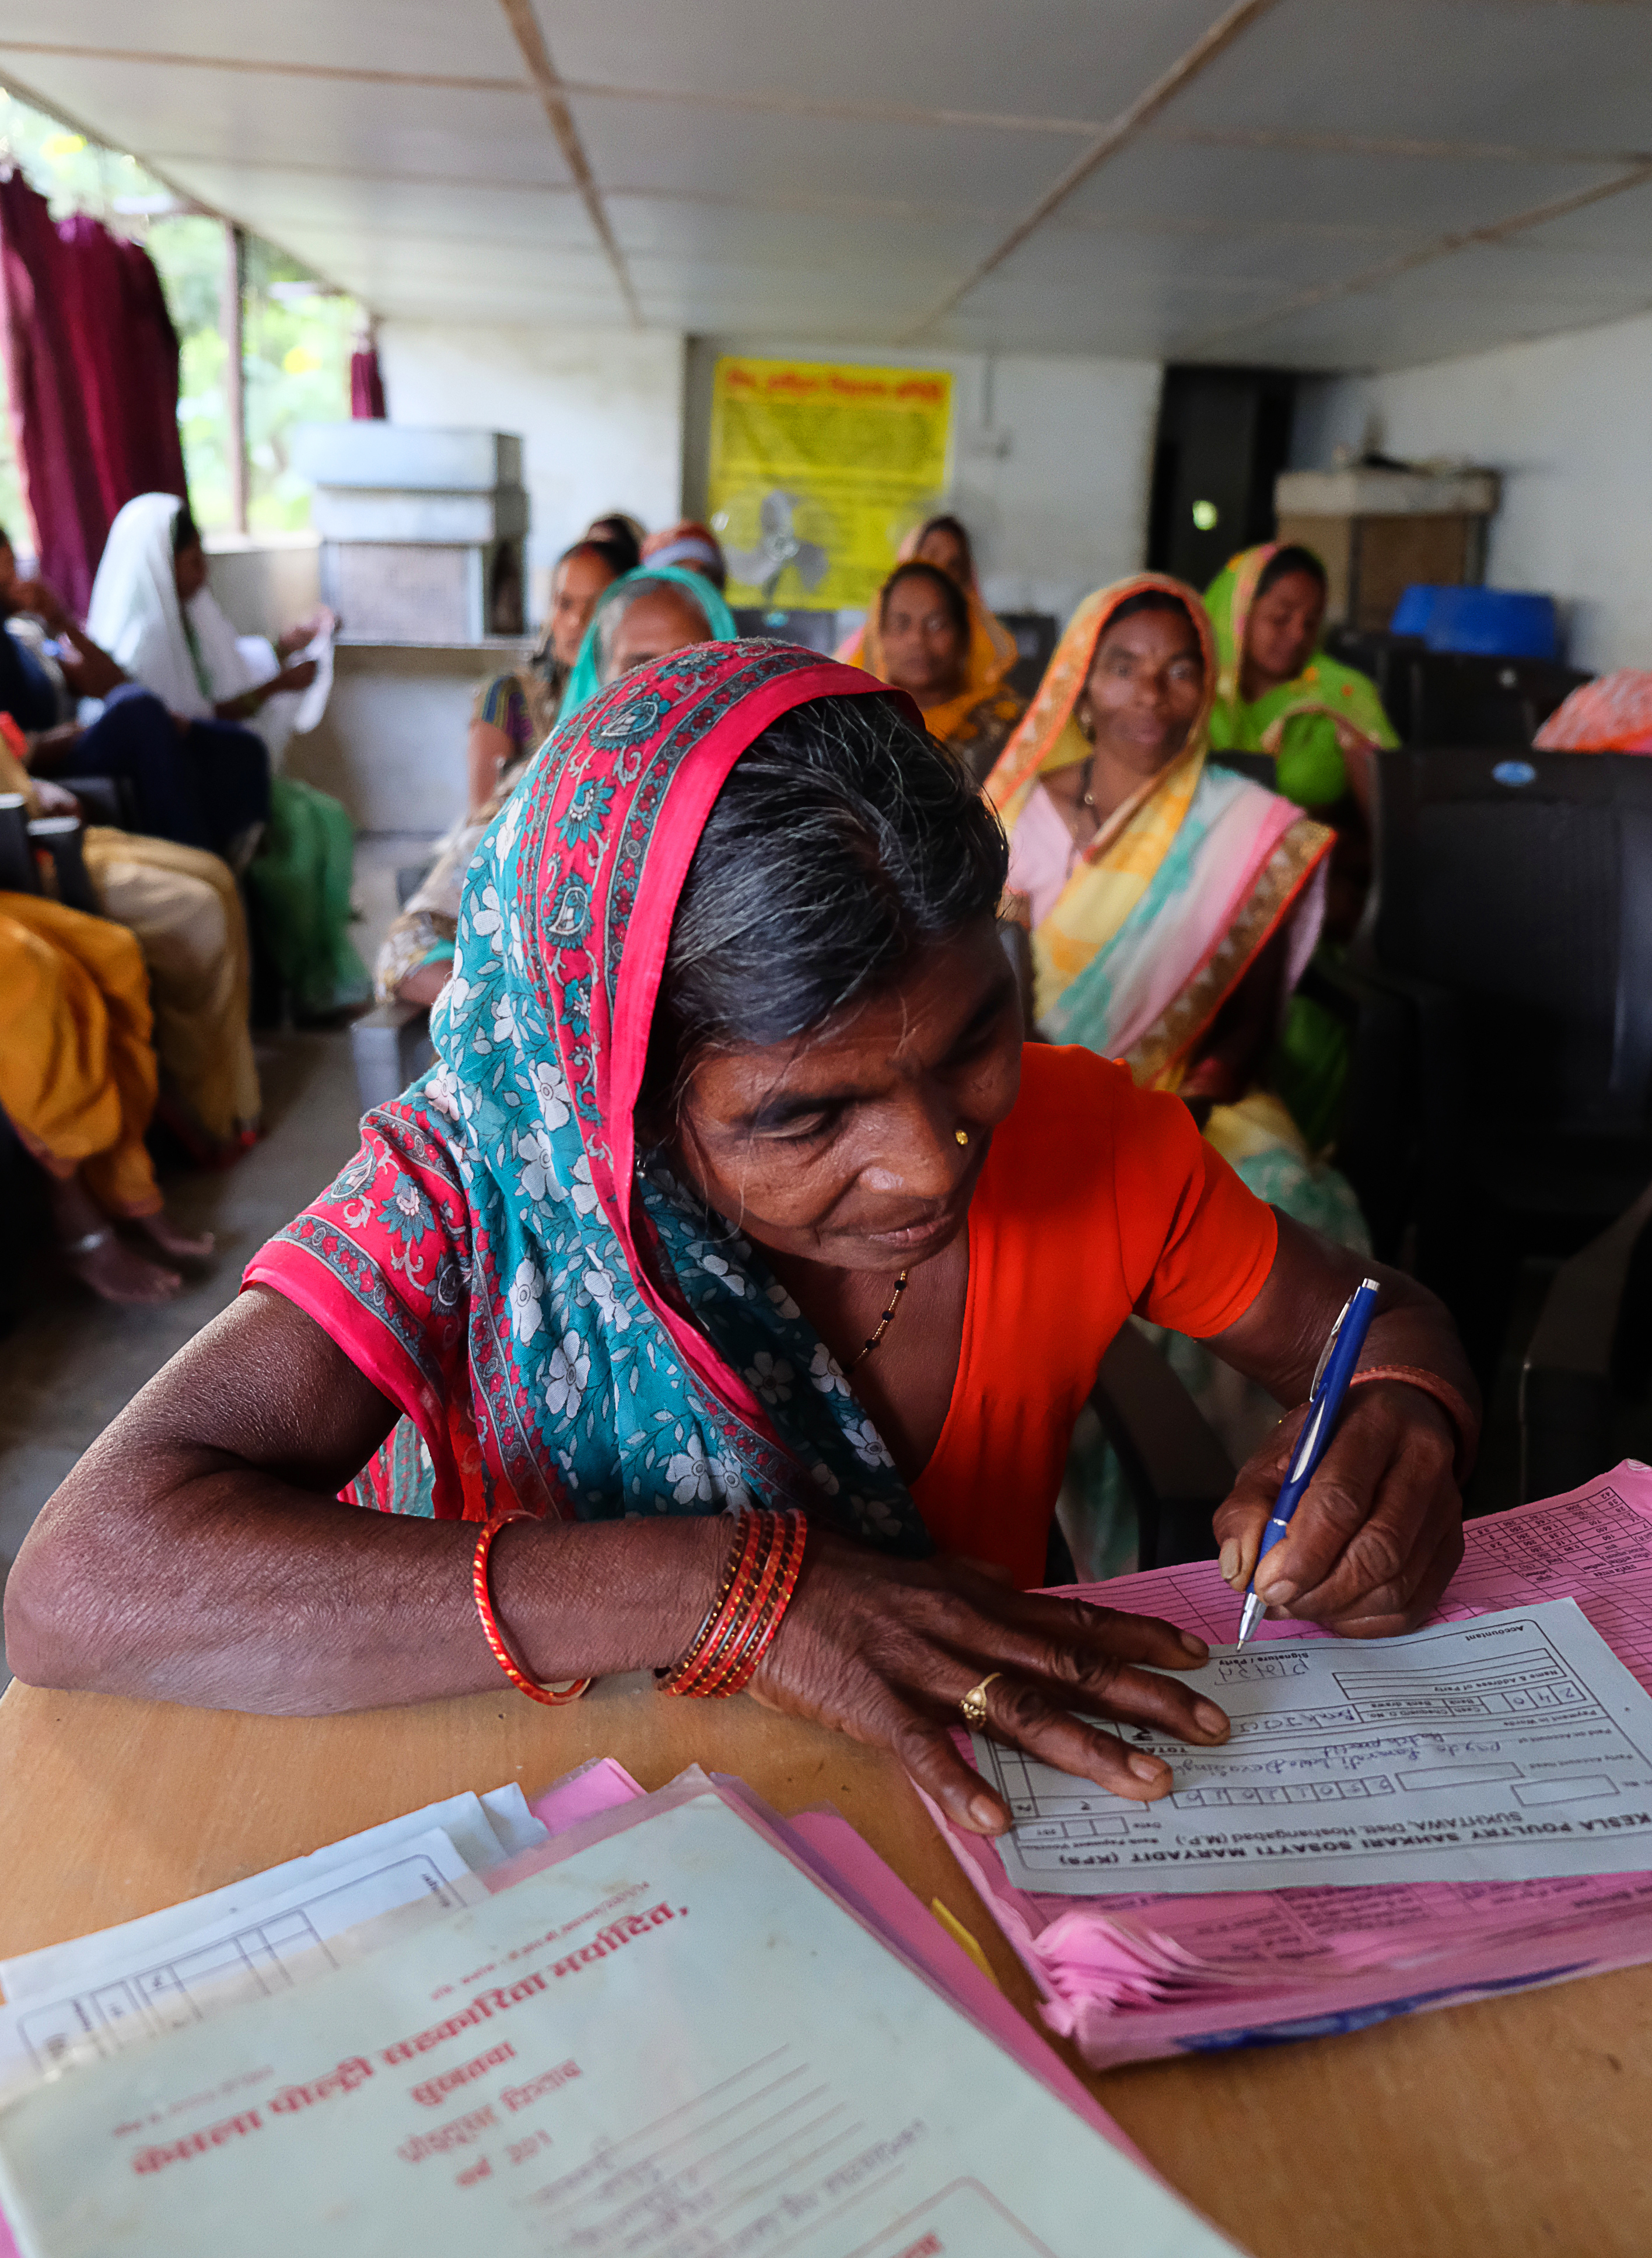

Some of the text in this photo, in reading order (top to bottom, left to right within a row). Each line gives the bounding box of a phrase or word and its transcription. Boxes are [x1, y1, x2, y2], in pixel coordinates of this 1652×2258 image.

[1608, 1498, 1618, 1507] 35
[1542, 1523, 1558, 1532] 1.50
[1548, 1530, 1565, 1539] 1.35
[1555, 1538, 1572, 1546] 1.15
[1464, 1625, 1524, 1642] Accountant
[1256, 1652, 1309, 1662] Signature
[1529, 1669, 1558, 1680] Name
[1462, 1683, 1474, 1691] of
[1475, 1677, 1517, 1689] Address
[1433, 1684, 1461, 1694] Party
[1452, 1706, 1481, 1714] Cash
[1550, 1710, 1597, 1722] Payment
[1503, 1718, 1536, 1727] Words
[1058, 1812, 1651, 1865] KESLA POULTRY SAHKARI SOSAYTI MARYADIT (KPS)
[1175, 1831, 1228, 1848] (M.P.)
[1232, 1826, 1357, 1844] Hoshangabad
